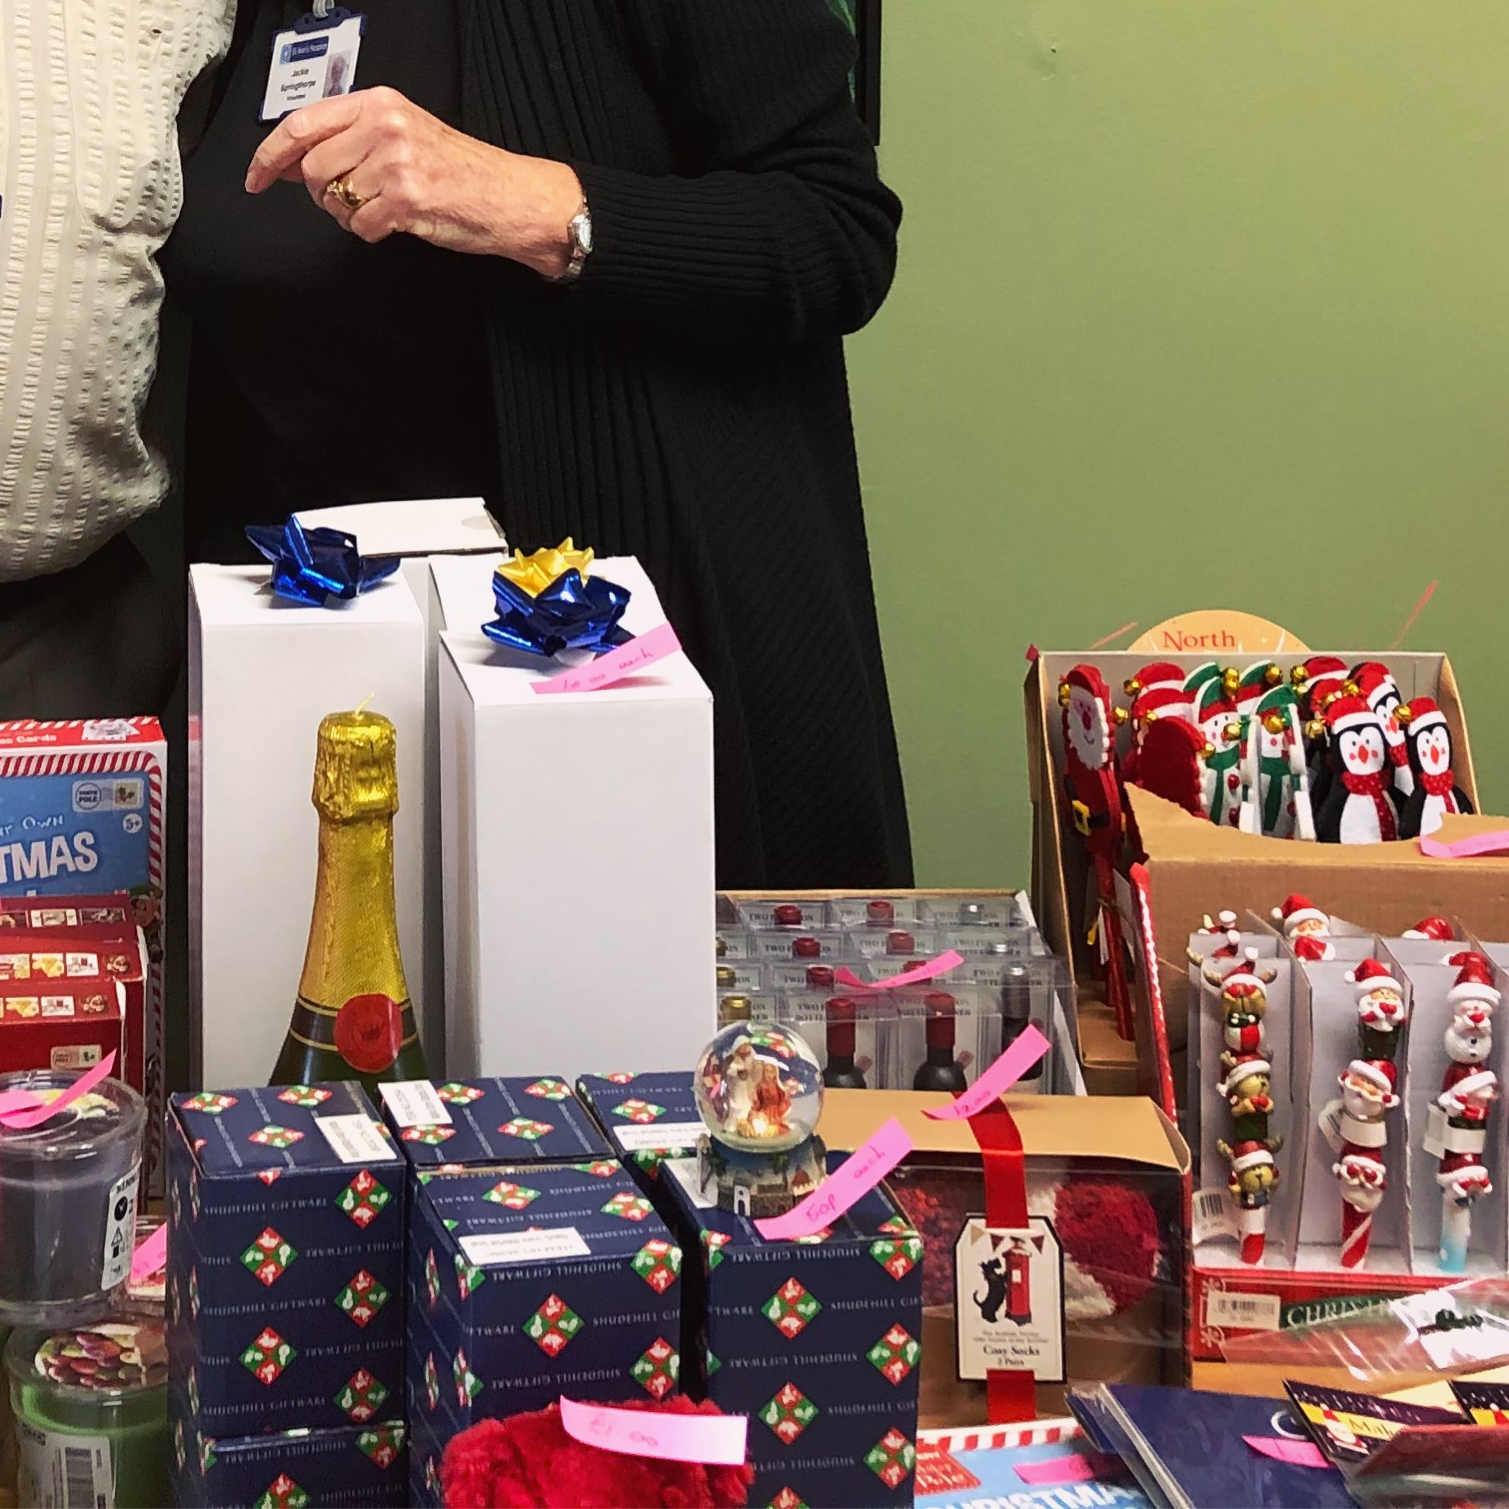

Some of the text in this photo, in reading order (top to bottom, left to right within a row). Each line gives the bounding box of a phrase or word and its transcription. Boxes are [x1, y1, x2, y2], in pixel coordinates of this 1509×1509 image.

[1163, 630, 1235, 651] North
[16, 734, 57, 744] Cards
[492, 1262, 622, 1282] SHUDEHILL GIFTWARE
[593, 1313, 658, 1328] SHUDEHILL
